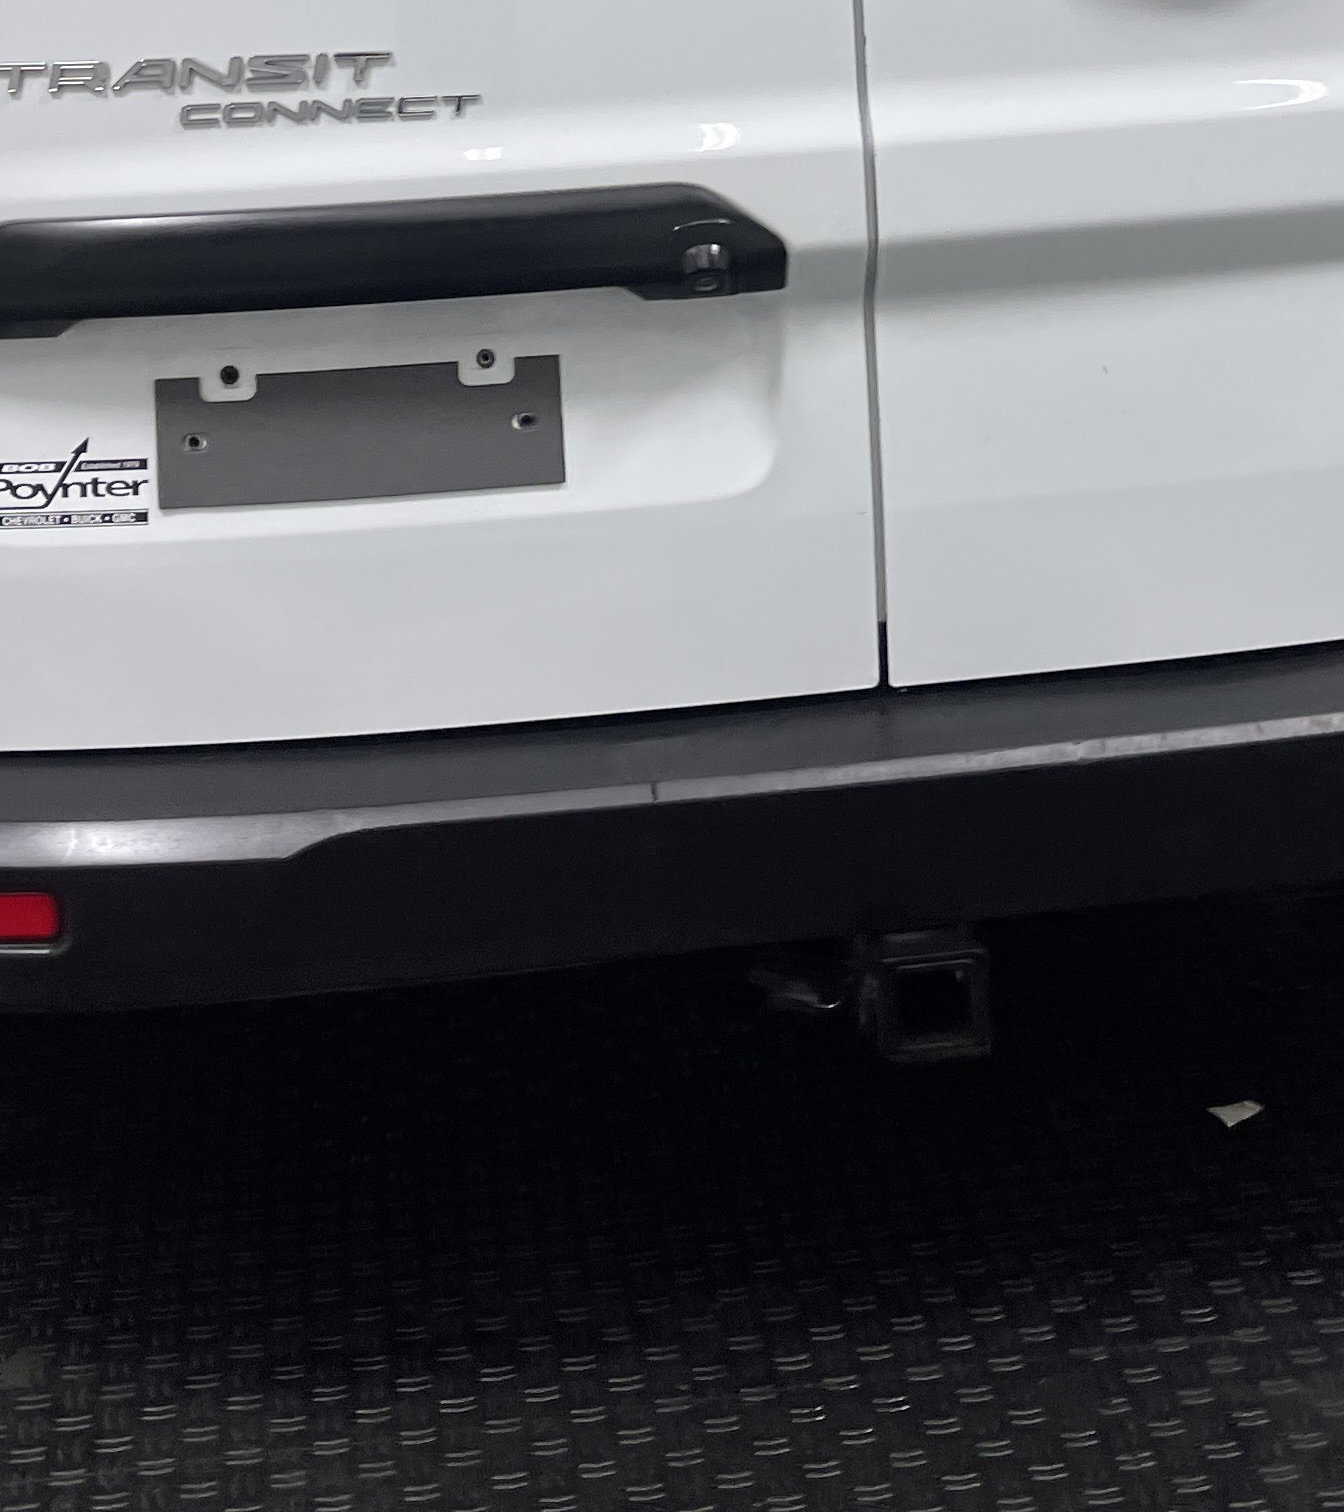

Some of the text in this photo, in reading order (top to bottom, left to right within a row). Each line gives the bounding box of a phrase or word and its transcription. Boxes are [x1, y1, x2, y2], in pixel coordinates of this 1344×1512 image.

[179, 94, 482, 130] CONNECT
[1, 463, 57, 473] BOB
[1, 515, 61, 526] CHEVROLET
